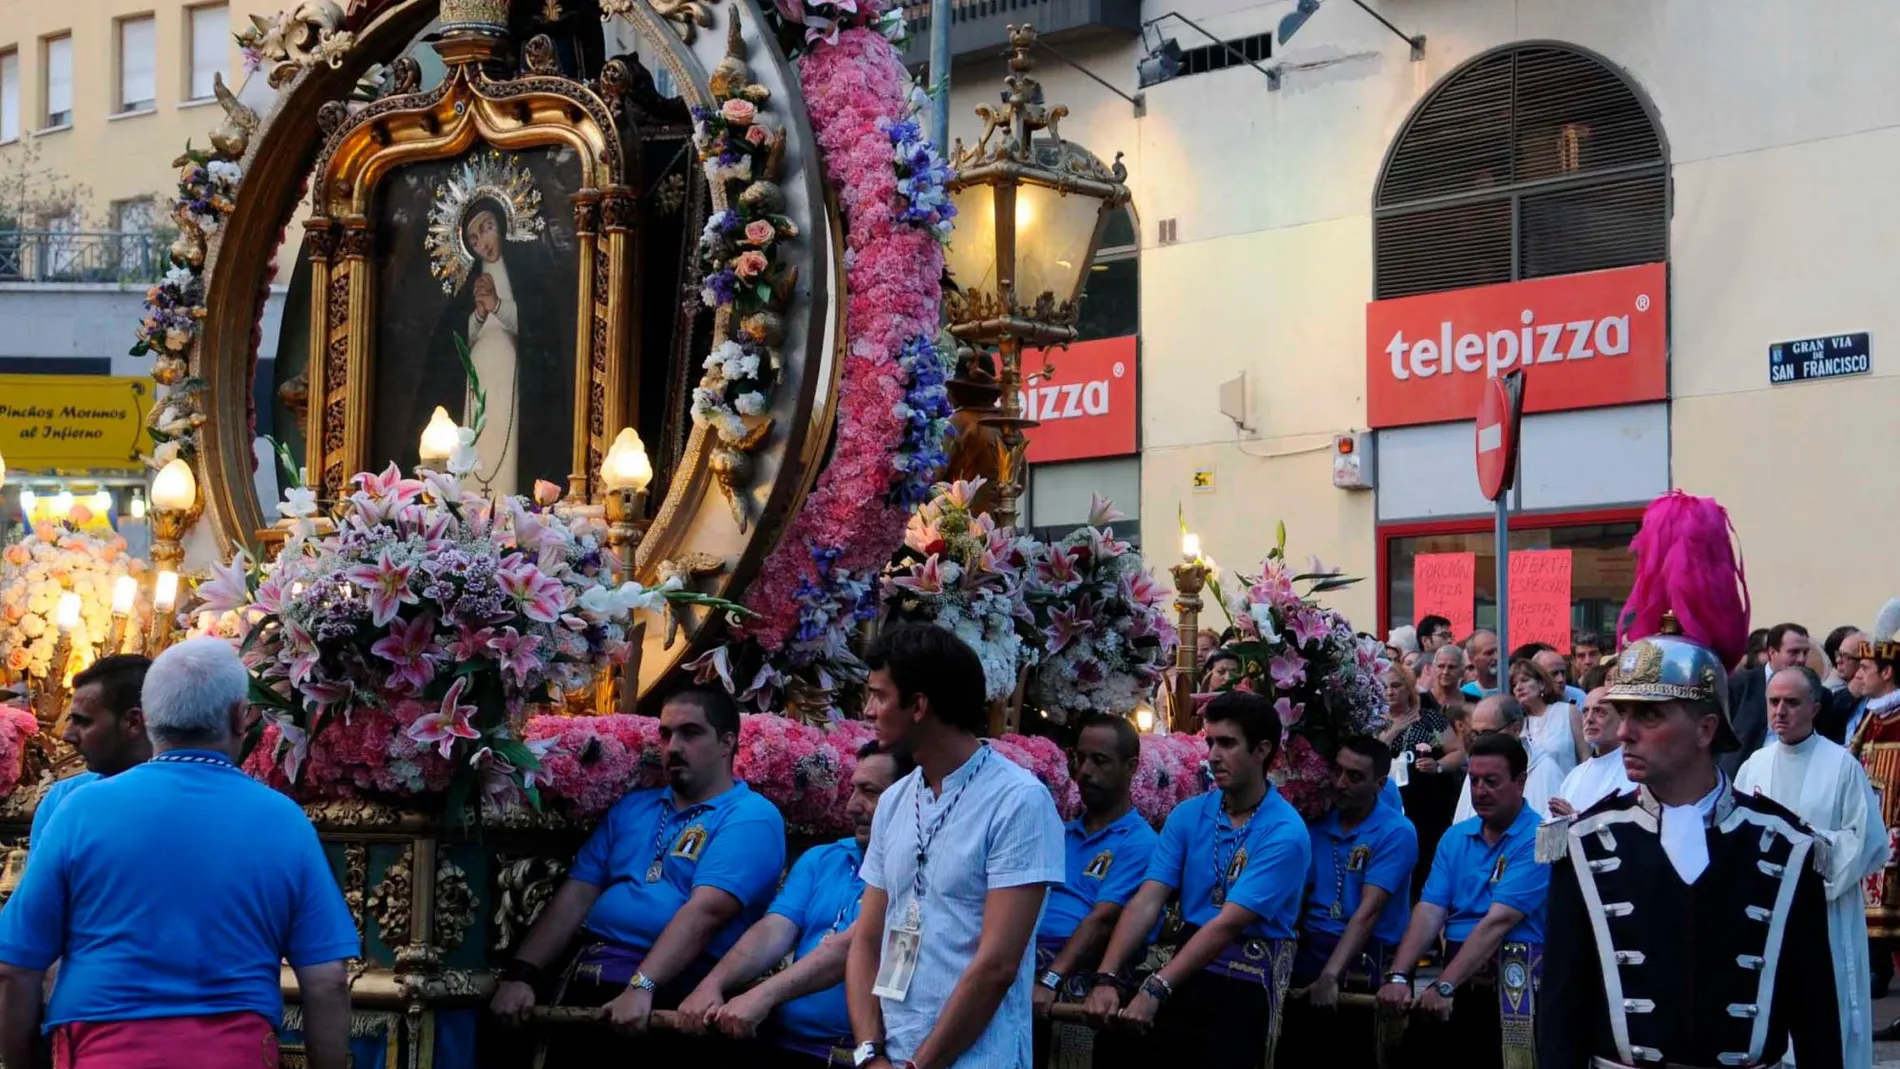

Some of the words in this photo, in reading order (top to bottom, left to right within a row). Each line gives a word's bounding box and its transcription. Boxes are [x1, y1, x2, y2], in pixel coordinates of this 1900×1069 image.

[1385, 309, 1630, 379] telepizza
[1792, 340, 1825, 354] GRAN
[1832, 336, 1852, 349] VIA
[1812, 351, 1825, 360] DE
[1772, 363, 1794, 381] SAN
[1803, 354, 1867, 378] FRANCISCO
[59, 406, 127, 419] Morunos
[20, 426, 38, 438] al
[42, 425, 103, 441] Infierno
[1510, 554, 1570, 575] OFERTA
[1426, 581, 1463, 596] PIZZA
[1510, 598, 1558, 617] FIESTAS
